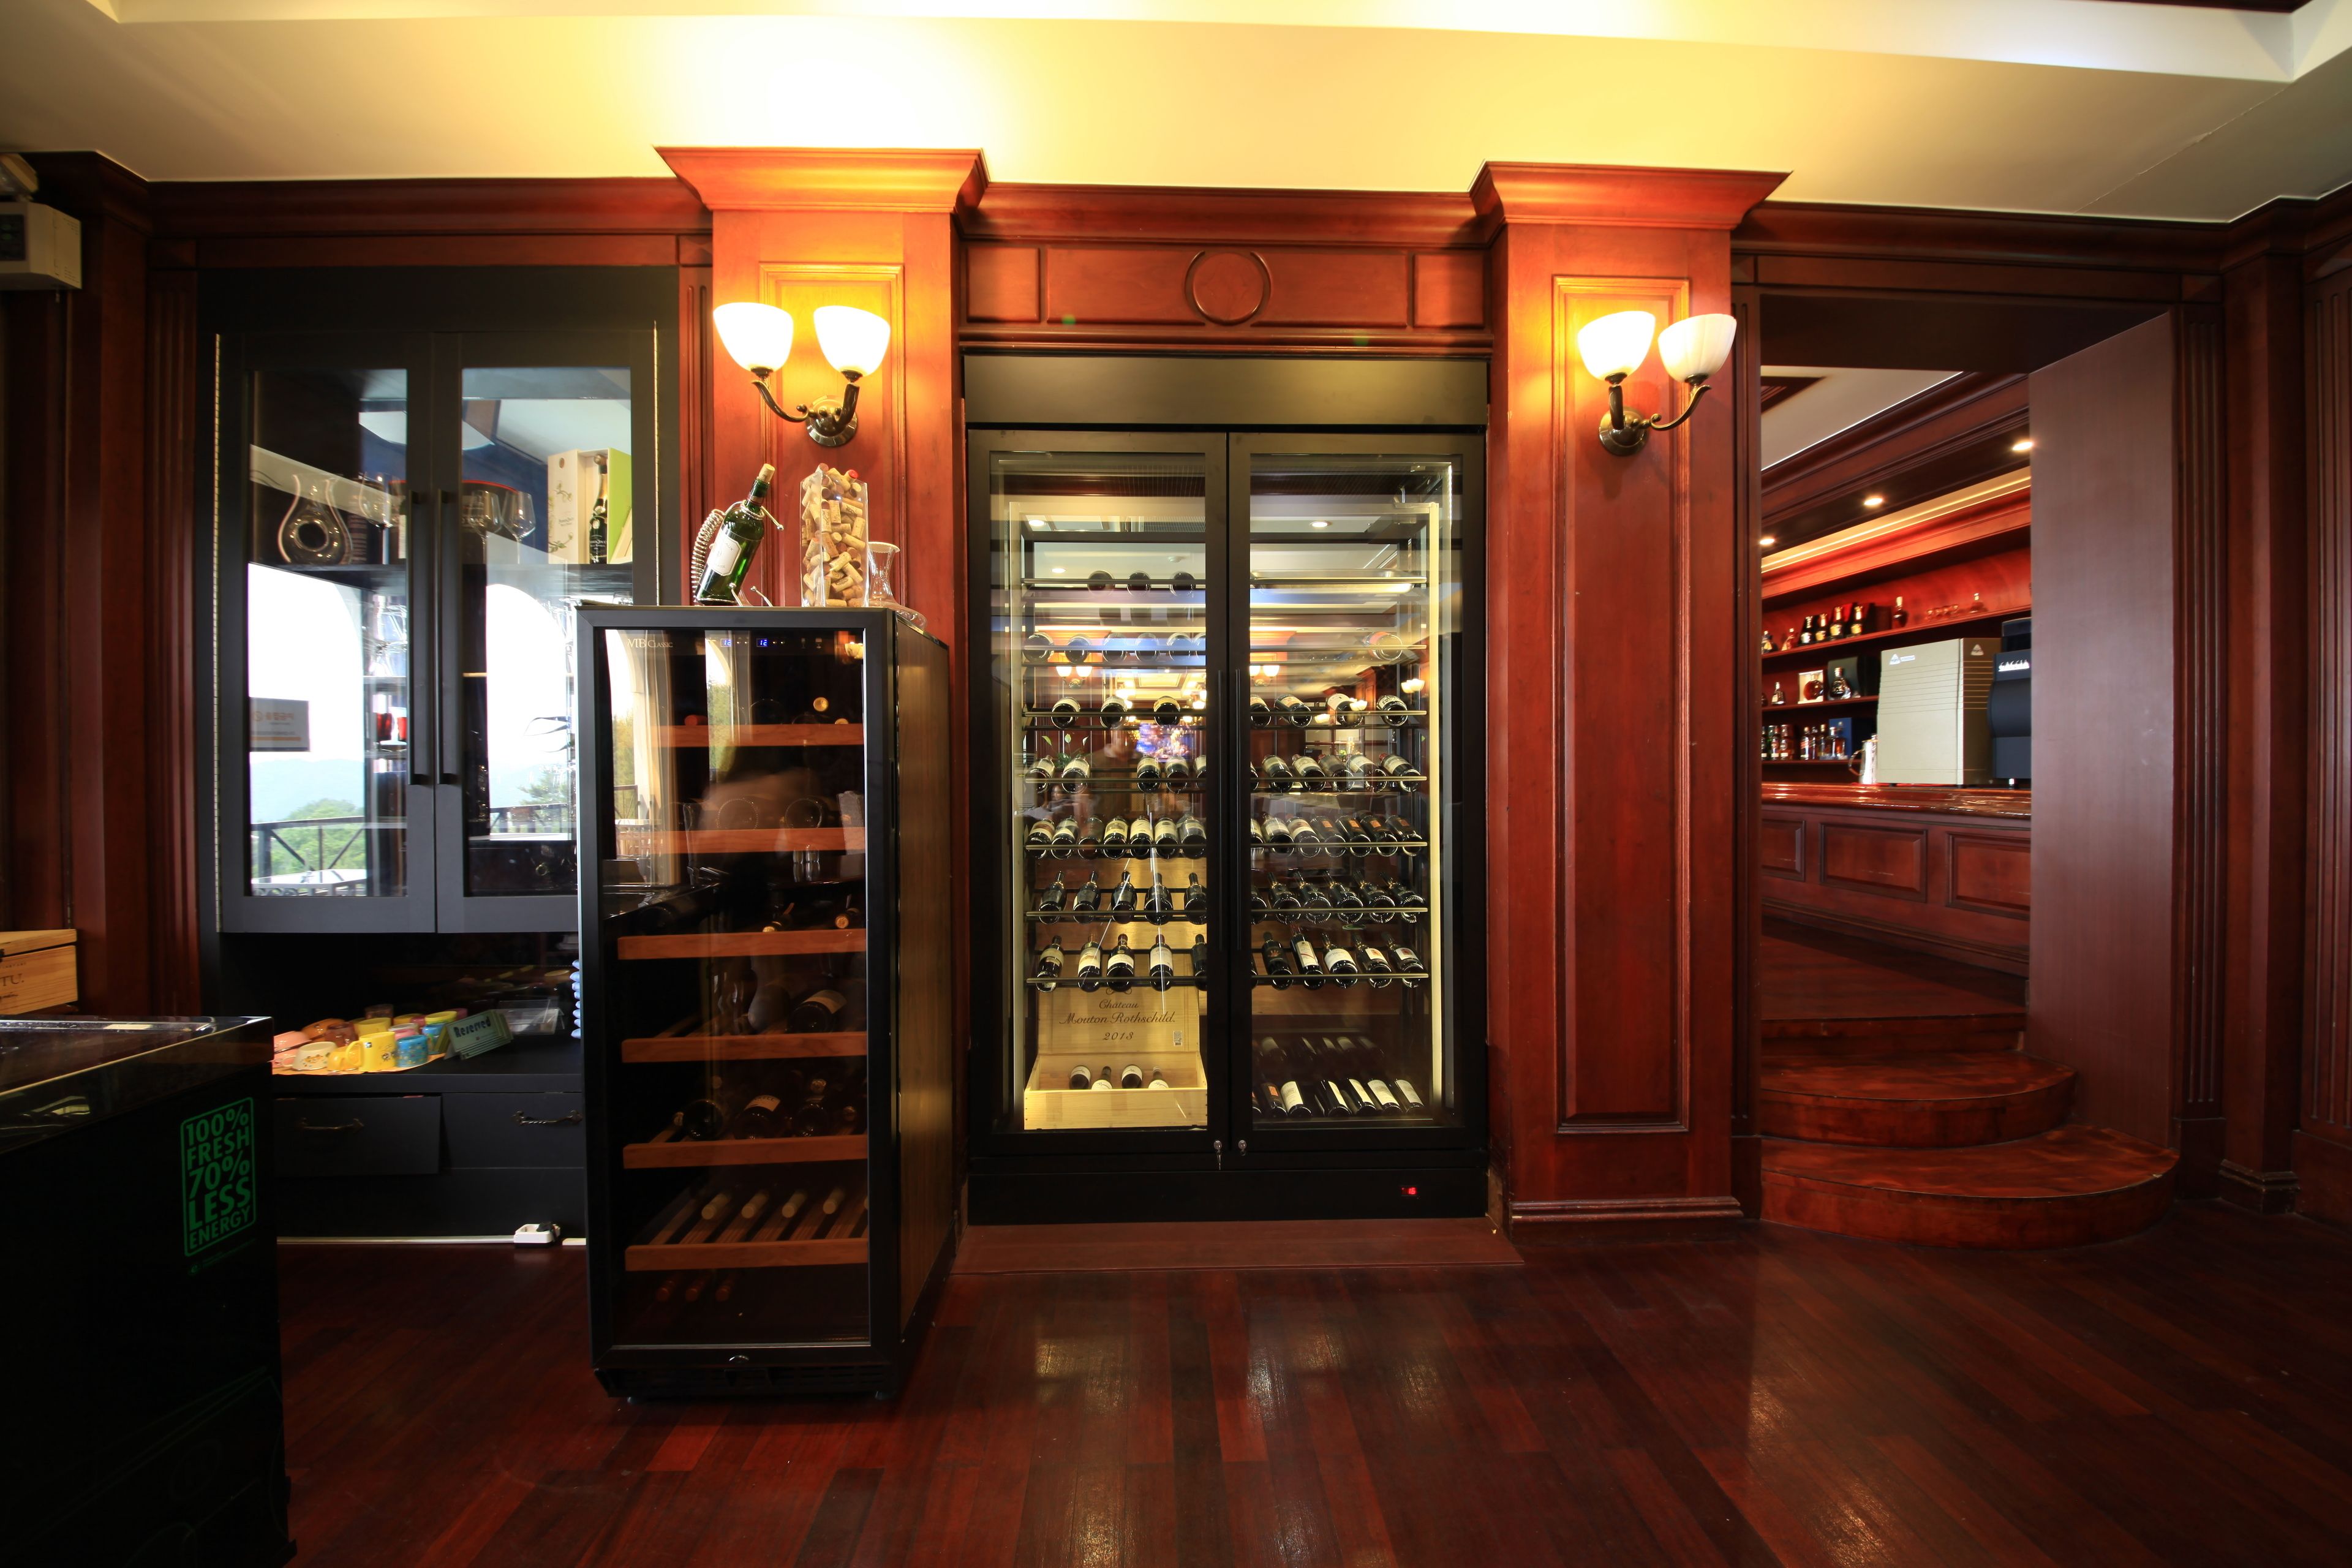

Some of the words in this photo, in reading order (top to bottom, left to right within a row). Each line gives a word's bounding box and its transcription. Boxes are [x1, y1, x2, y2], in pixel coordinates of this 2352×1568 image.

[453, 1016, 491, 1038] Reserved
[1059, 1012, 1108, 1024] Mouton
[1109, 1011, 1176, 1024] Rothschild.
[187, 1106, 249, 1146] 100%
[188, 1126, 250, 1170] FRESH
[189, 1150, 251, 1200] 70%
[189, 1177, 251, 1232] LESS
[189, 1205, 251, 1250] ENERGY
